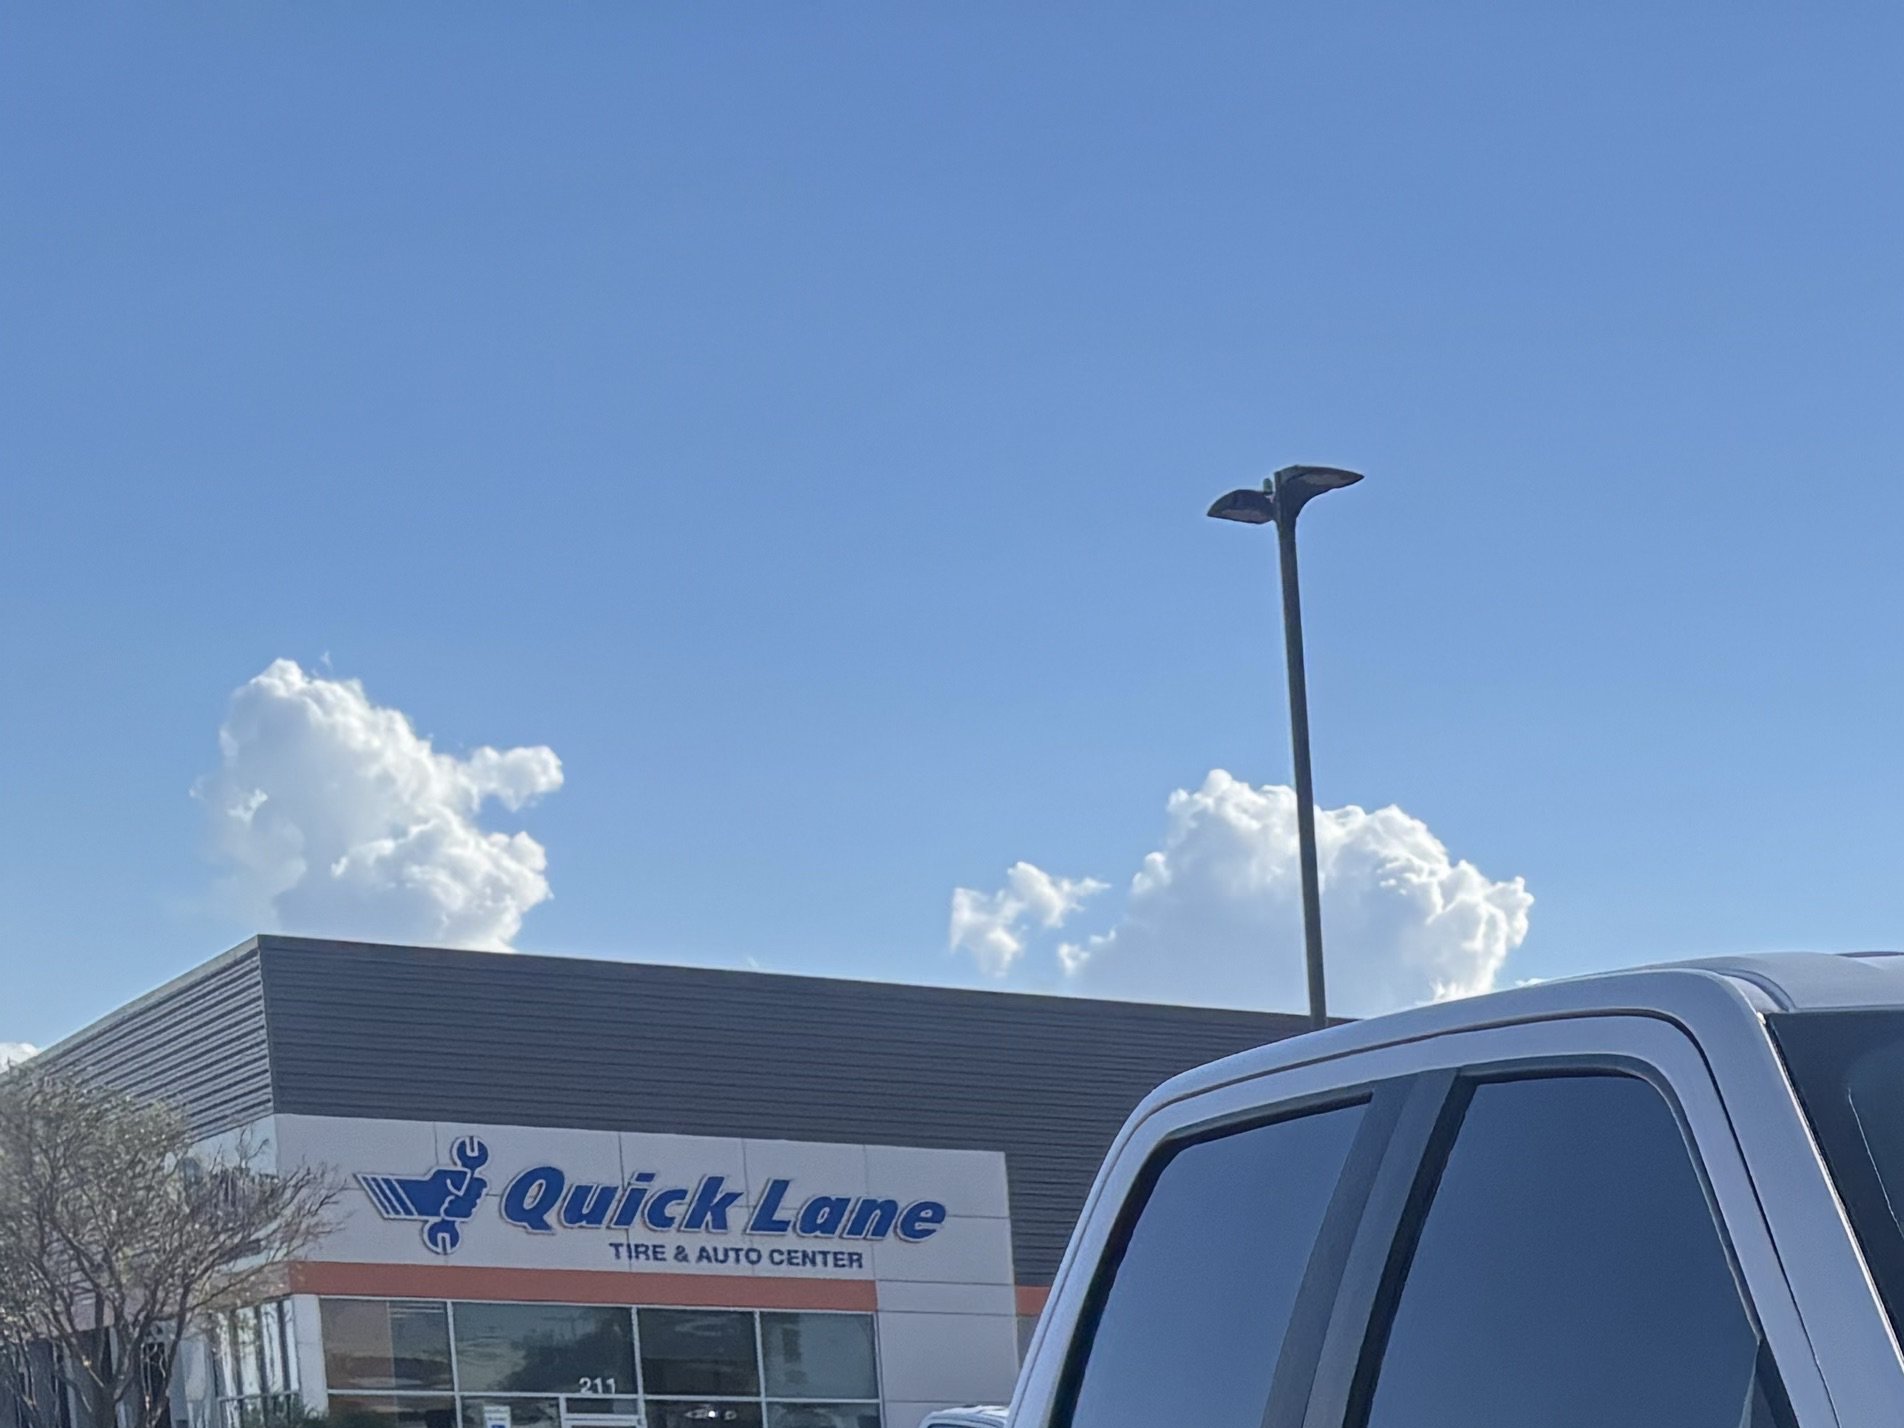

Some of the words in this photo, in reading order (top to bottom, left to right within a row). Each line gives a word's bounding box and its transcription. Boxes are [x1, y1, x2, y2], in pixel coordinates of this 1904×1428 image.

[501, 1165, 743, 1235] Quick
[746, 1178, 948, 1243] Lane
[609, 1241, 668, 1263] TIRE
[673, 1244, 690, 1264] &
[696, 1245, 762, 1267] AUTO
[768, 1247, 864, 1270] CENTER
[578, 1376, 617, 1395] 211
